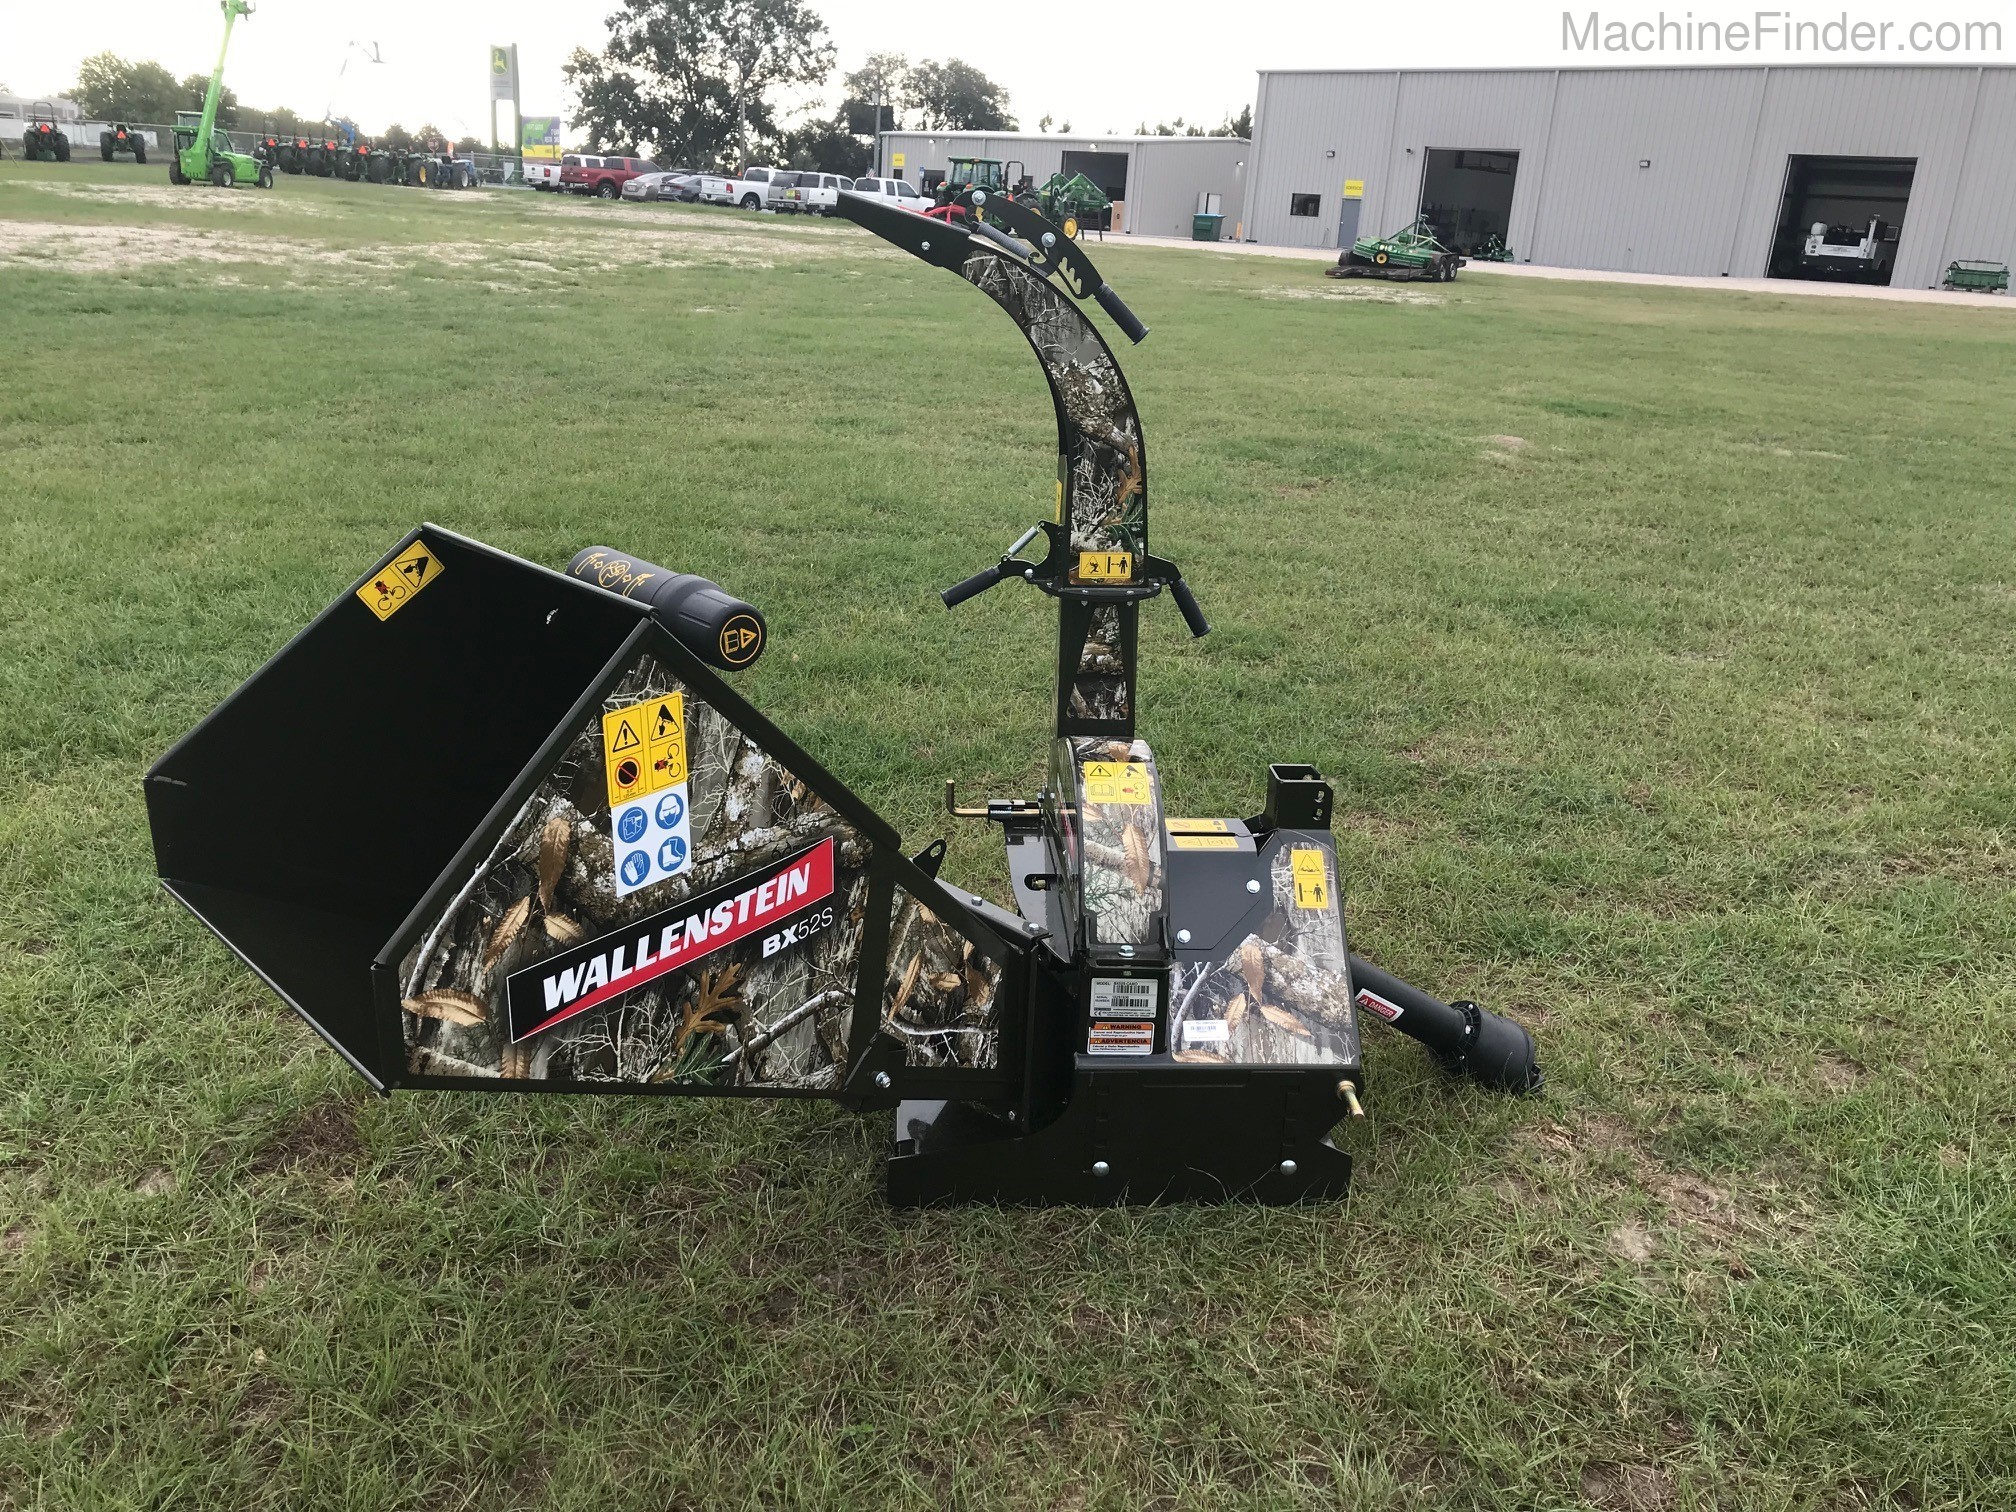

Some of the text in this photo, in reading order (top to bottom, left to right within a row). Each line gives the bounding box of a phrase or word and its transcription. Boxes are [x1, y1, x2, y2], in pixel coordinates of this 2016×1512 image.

[543, 862, 810, 1012] WALLENSTEIN
[761, 907, 834, 959] BX52S
[1368, 1001, 1394, 1017] DANGER
